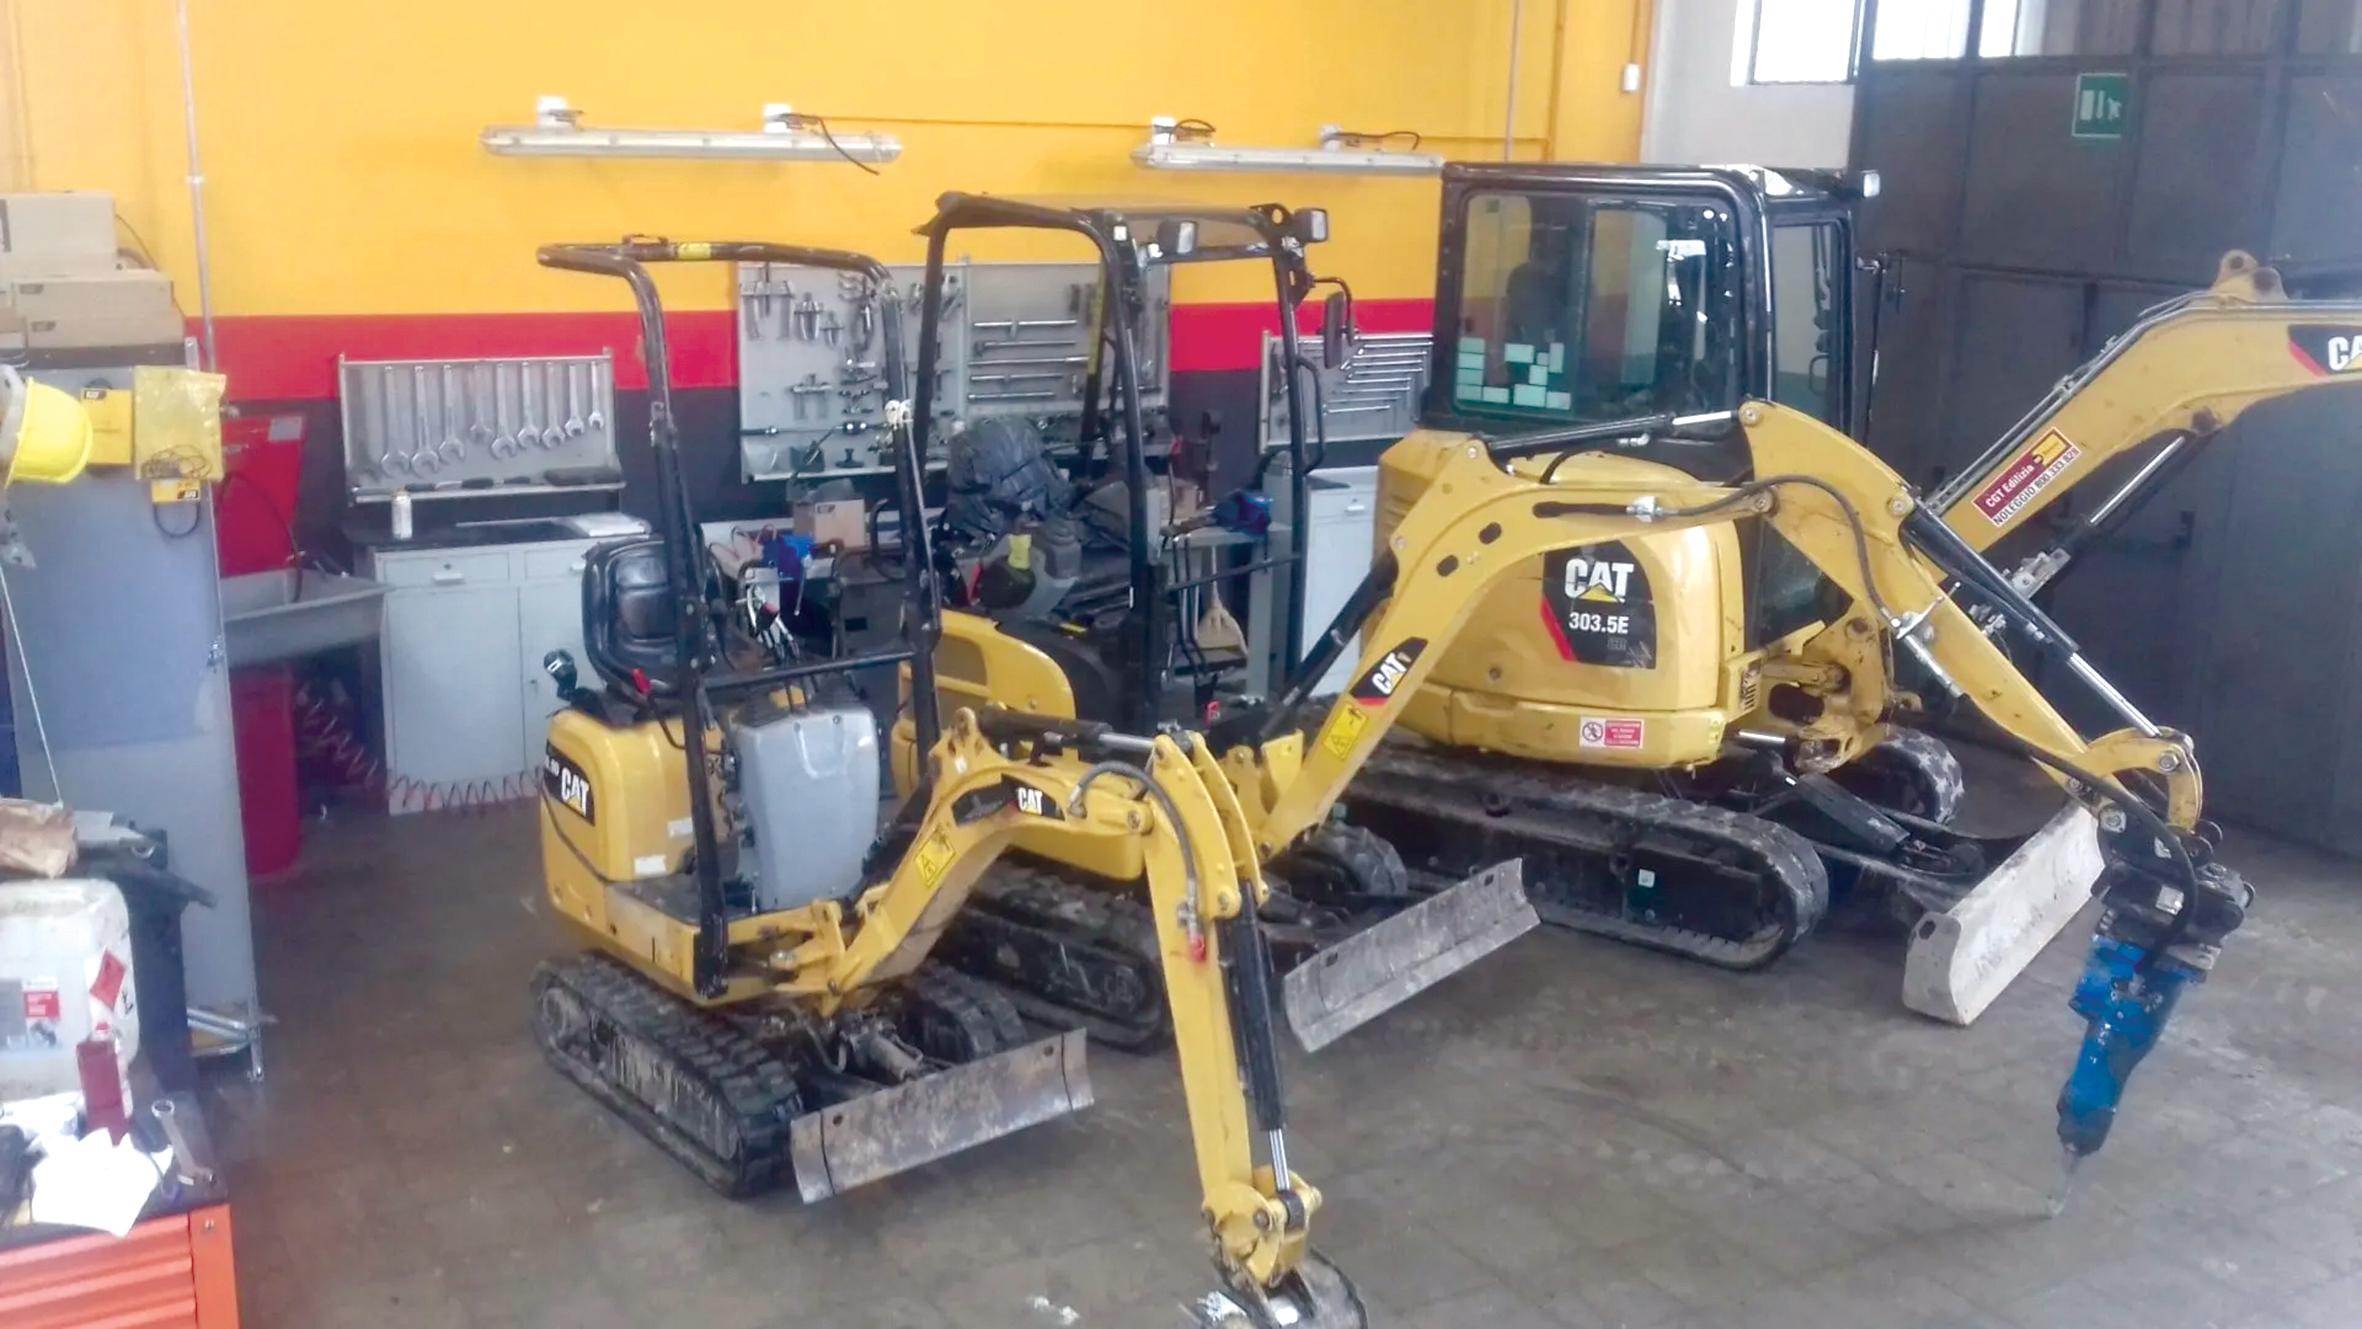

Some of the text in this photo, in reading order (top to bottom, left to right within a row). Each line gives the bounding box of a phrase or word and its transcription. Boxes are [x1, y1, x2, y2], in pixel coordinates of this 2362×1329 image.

[1985, 464, 2035, 508] CGT Edilizia
[1993, 487, 2036, 525] NOLEGGIO
[1564, 558, 1634, 603] CAT
[1568, 612, 1630, 634] 303.5E
[1372, 652, 1407, 695] CAT
[561, 767, 590, 817] CAT
[1017, 786, 1043, 816] CAT
